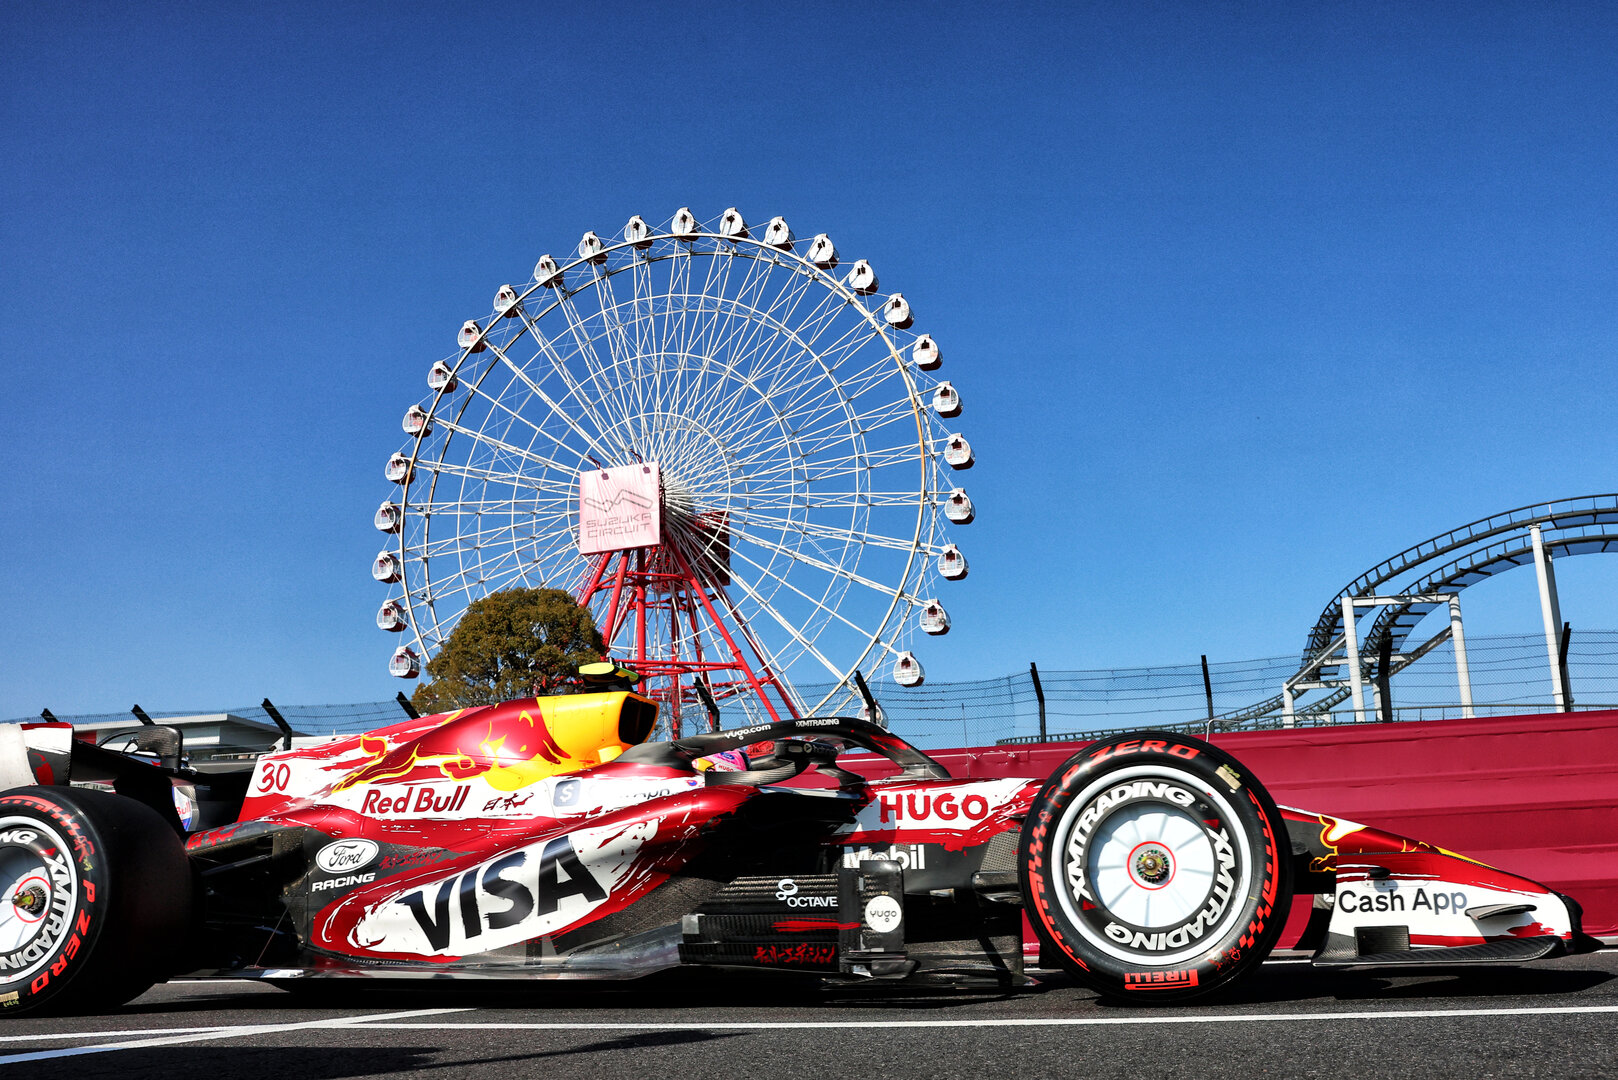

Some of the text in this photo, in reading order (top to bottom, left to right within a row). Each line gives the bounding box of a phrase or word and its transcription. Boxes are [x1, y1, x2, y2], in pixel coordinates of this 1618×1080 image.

[585, 512, 652, 528] SUZUKA
[587, 523, 651, 538] CIRCUIT
[724, 724, 771, 740] yugo.com
[796, 718, 840, 728] XMTRADING
[1087, 739, 1201, 766] ZERO
[257, 762, 291, 793] 30
[361, 785, 471, 815] Red Bull
[879, 791, 989, 824] HUGO
[1067, 781, 1196, 902] XMTRADING
[329, 845, 366, 867] Ford
[312, 872, 376, 893] RACING
[395, 835, 609, 952] VISA
[1104, 827, 1236, 951] XMTRADING
[0, 853, 72, 971] XMTRADIN
[787, 896, 839, 908] OCTAVE
[1338, 887, 1468, 916] Cash App
[870, 910, 897, 923] yugo
[31, 908, 92, 995] ZERO
[1124, 968, 1199, 990] PIRELLI
